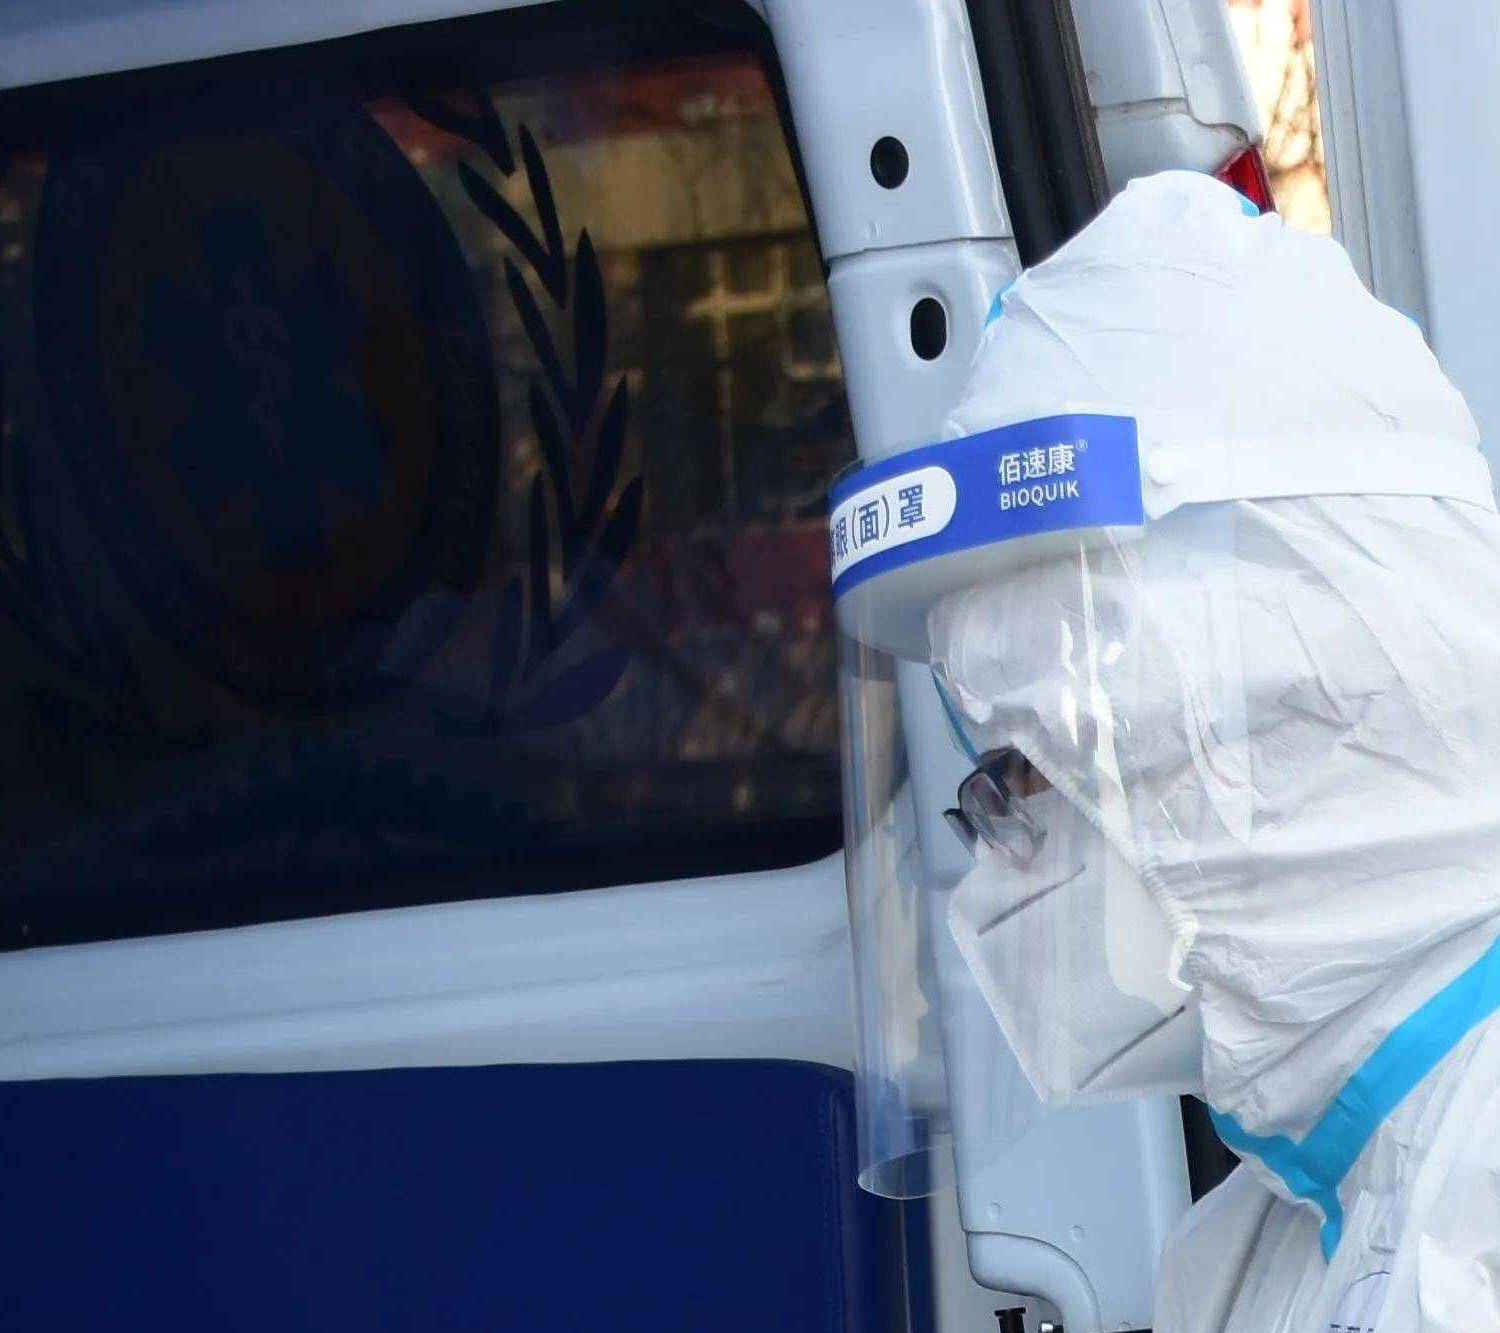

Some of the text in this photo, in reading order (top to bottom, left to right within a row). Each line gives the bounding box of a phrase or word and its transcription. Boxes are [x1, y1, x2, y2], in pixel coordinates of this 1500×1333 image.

[998, 443, 1077, 486] 佰速康
[1000, 480, 1080, 511] BIOQUIK
